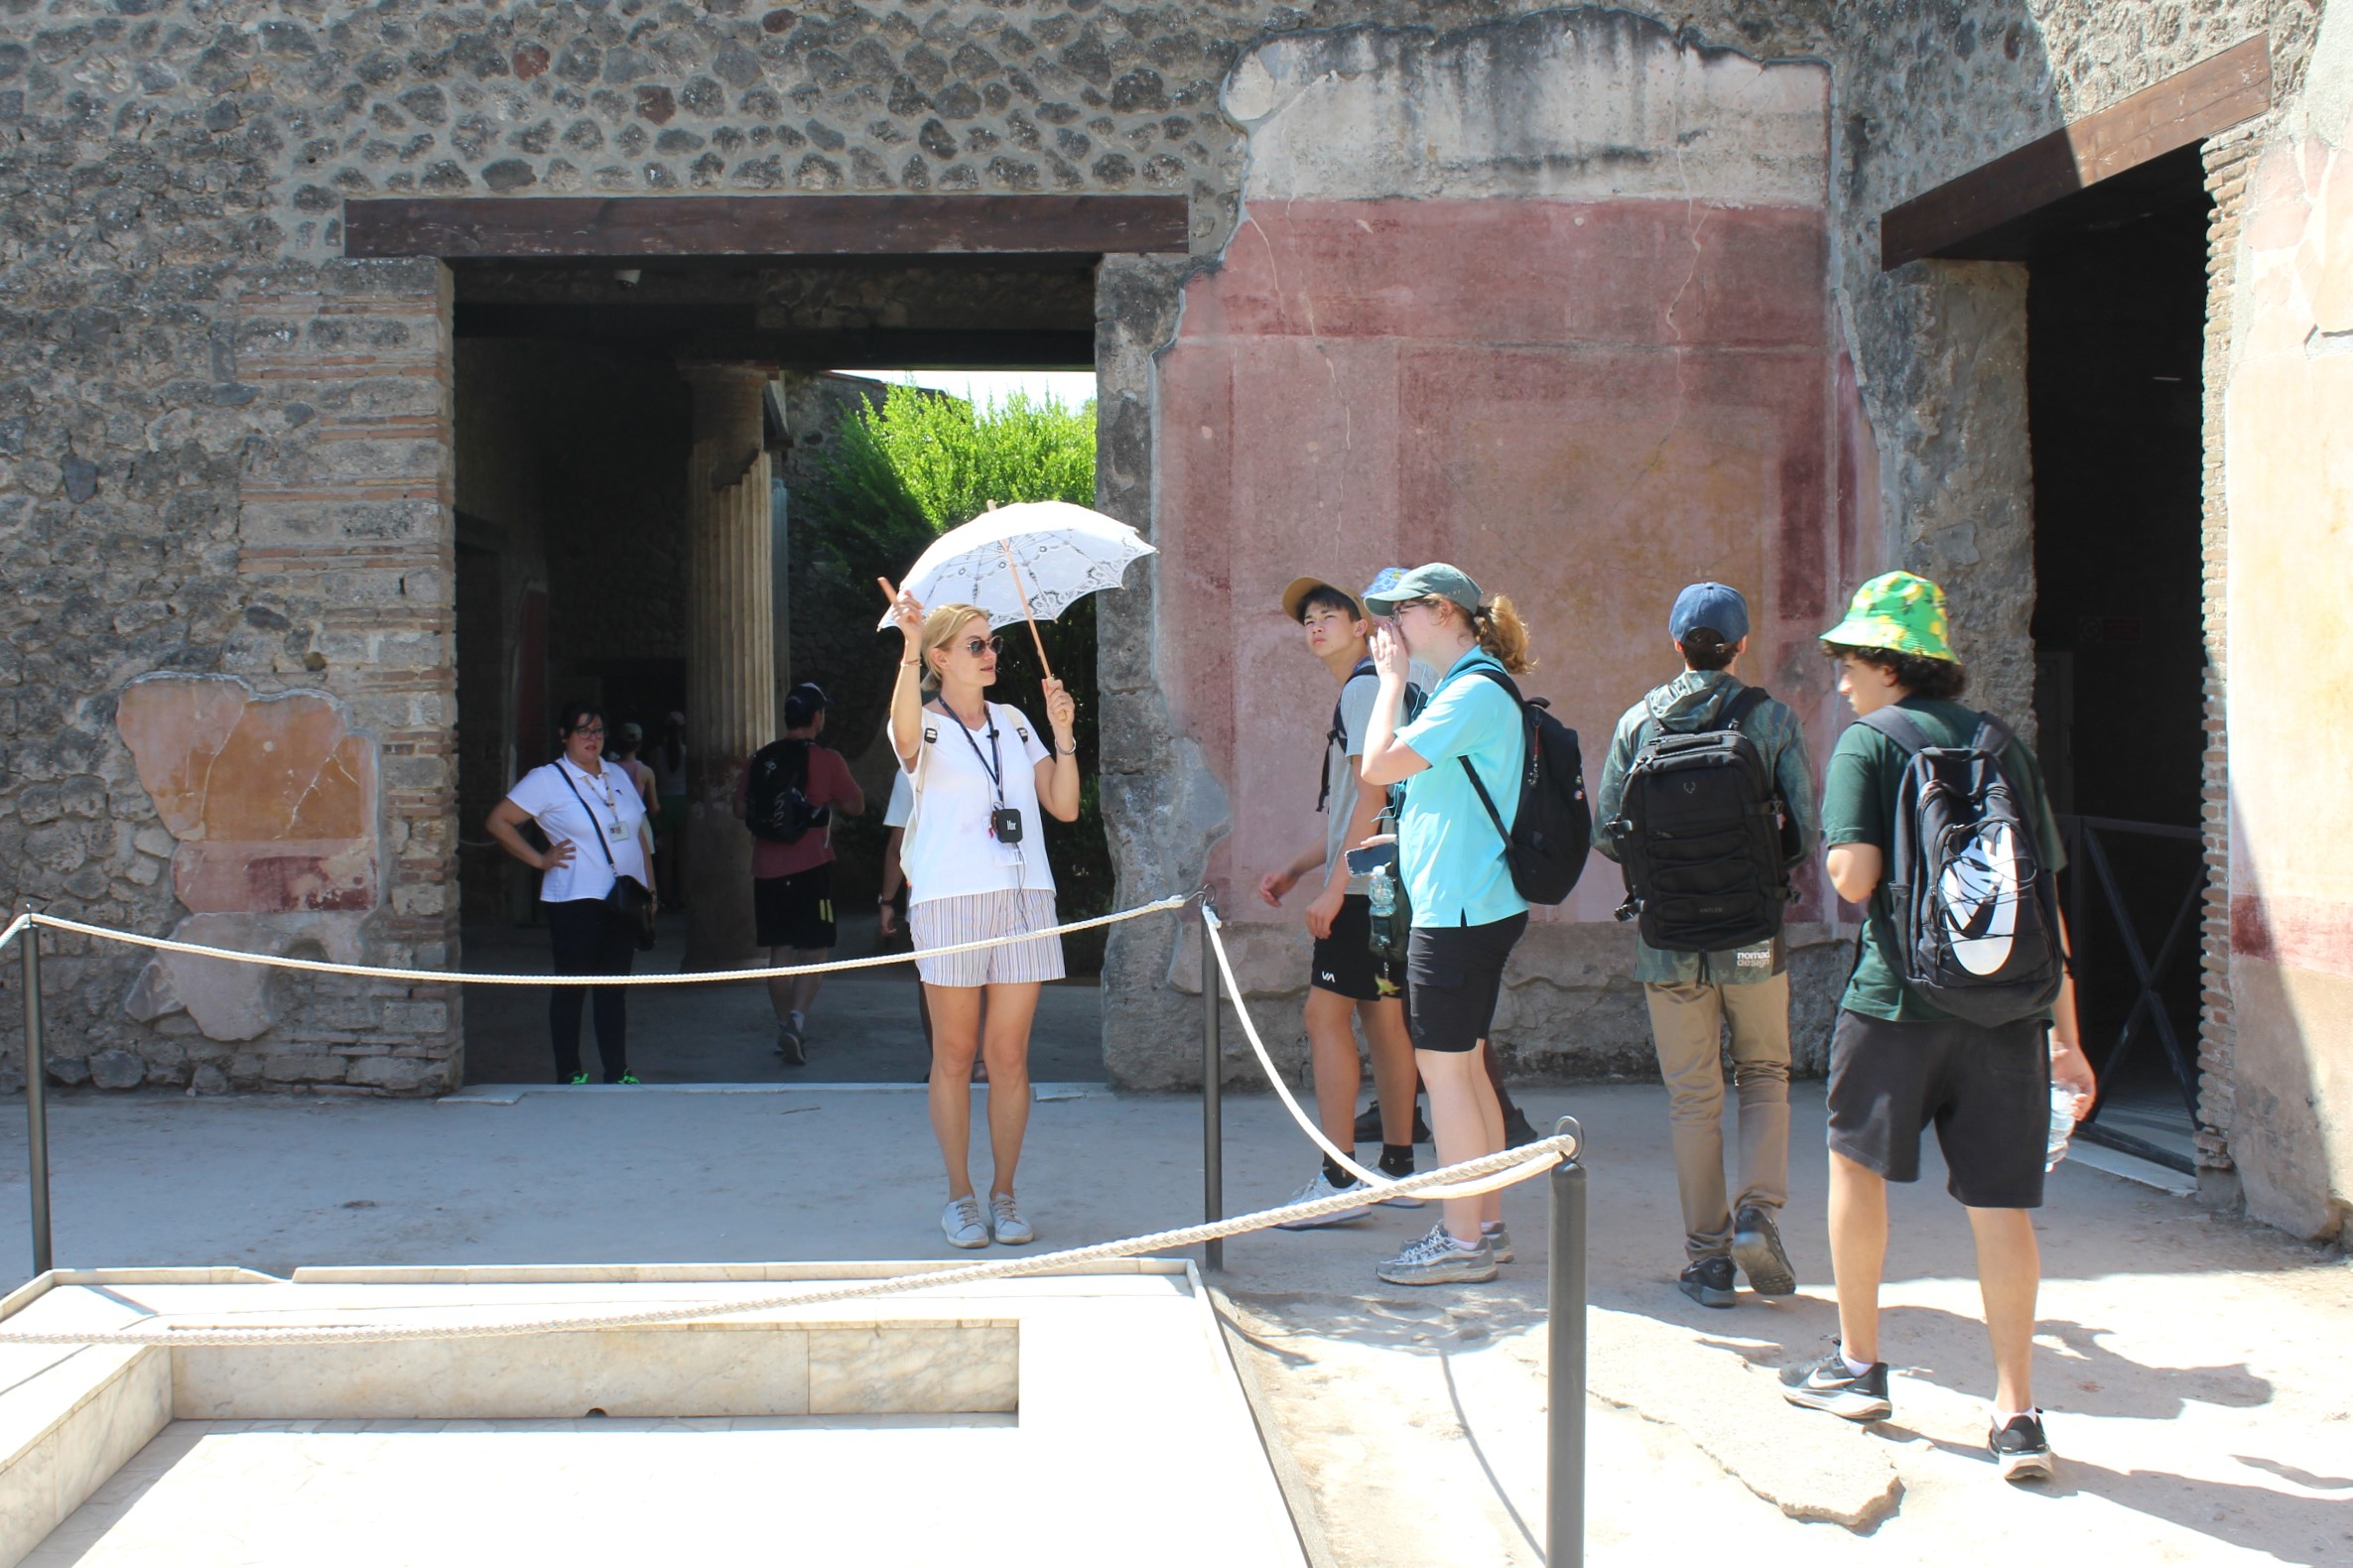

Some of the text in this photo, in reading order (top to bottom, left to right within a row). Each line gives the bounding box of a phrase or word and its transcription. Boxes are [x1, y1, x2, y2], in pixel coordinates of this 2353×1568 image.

[1006, 820, 1017, 831] Vox
[1737, 950, 1770, 960] nomad
[1737, 958, 1770, 968] design
